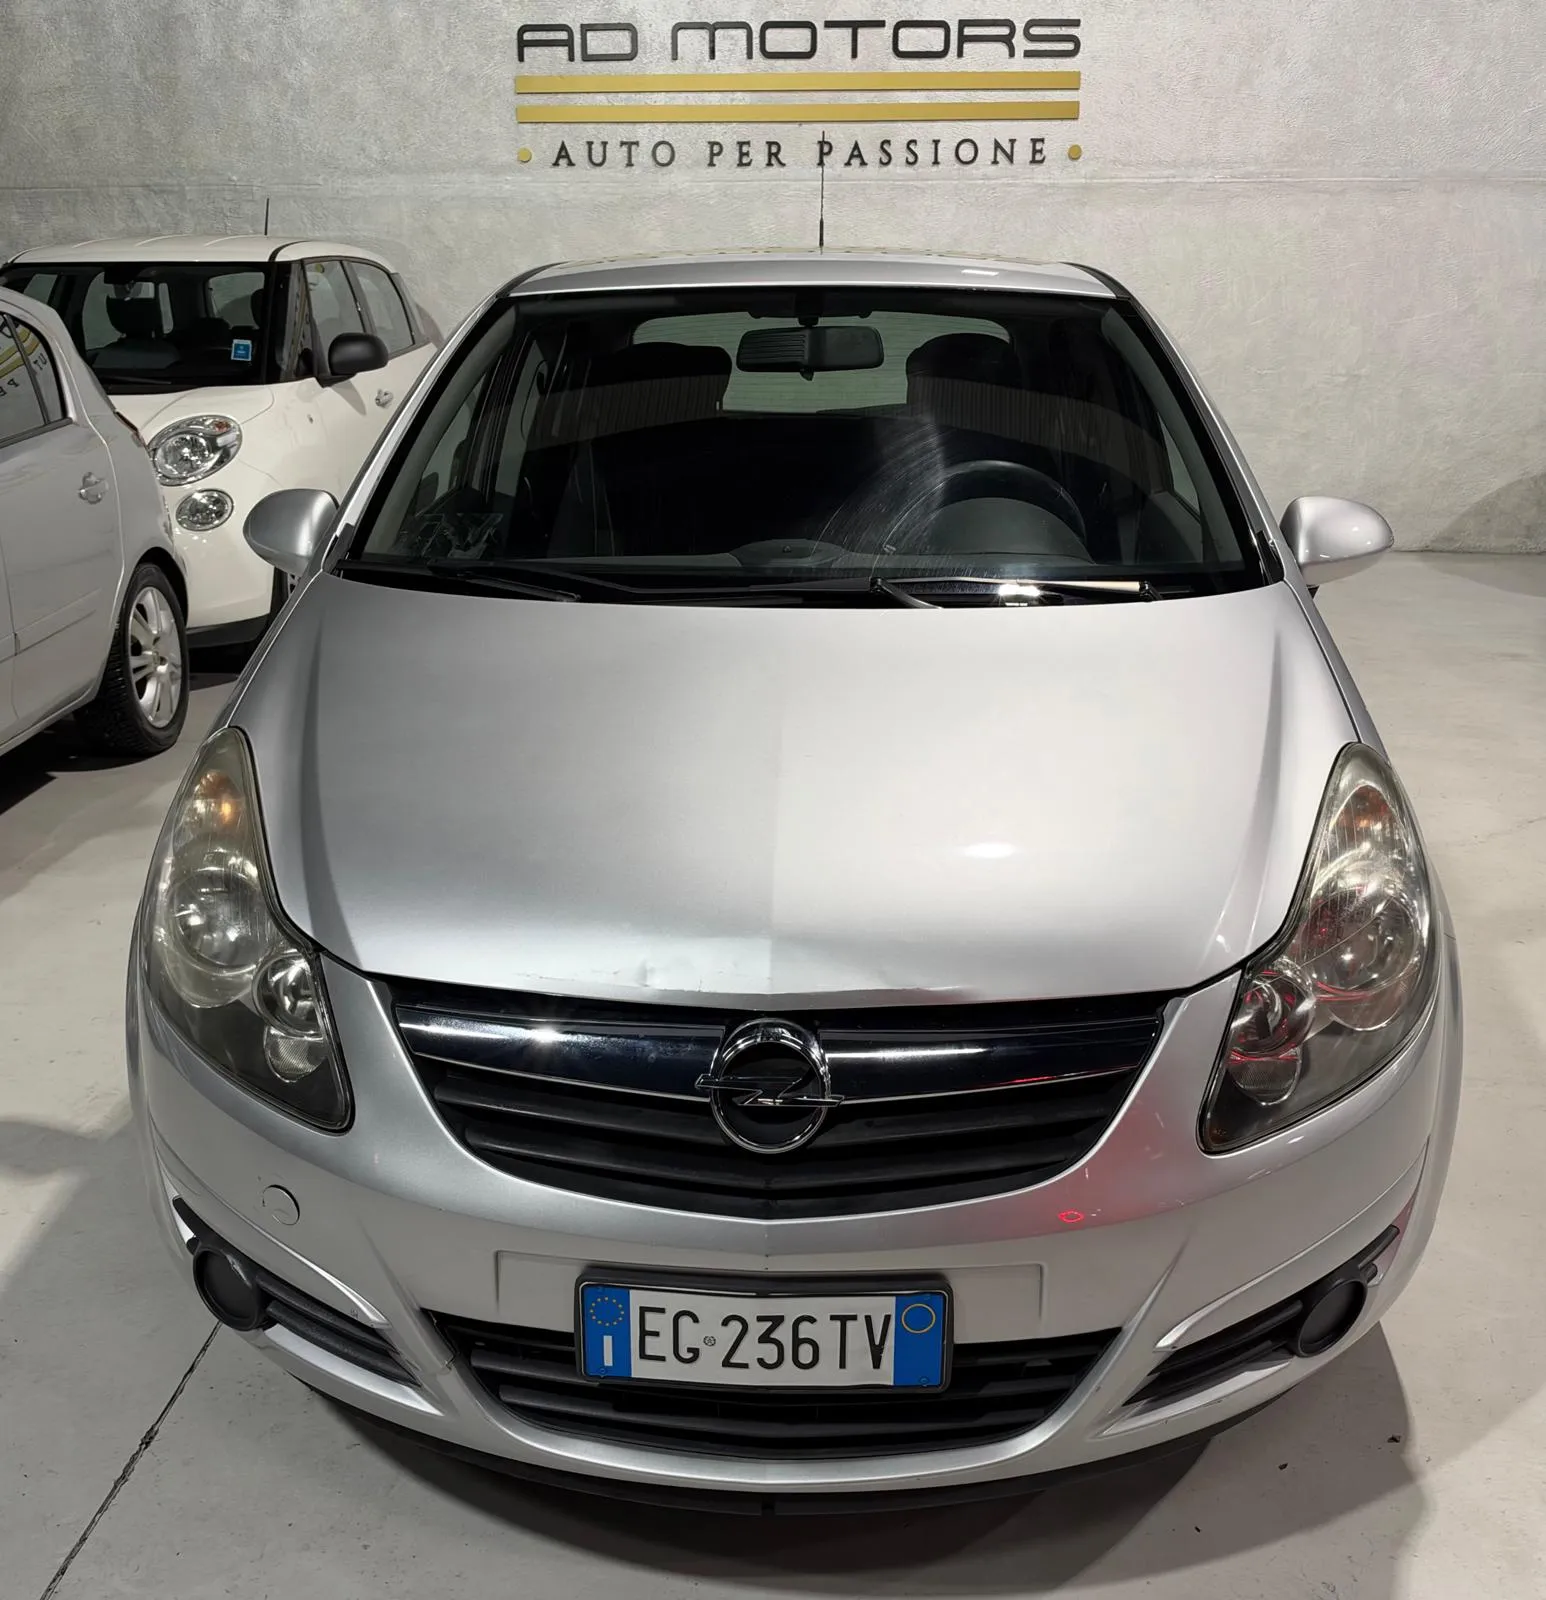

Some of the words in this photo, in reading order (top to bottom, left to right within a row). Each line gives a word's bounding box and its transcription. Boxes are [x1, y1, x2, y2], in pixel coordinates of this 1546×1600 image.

[516, 22, 639, 63] AD
[671, 18, 1081, 61] MOTORS
[551, 140, 676, 168] AUTO
[707, 140, 786, 168] PER
[815, 137, 1046, 168] PASSIONE
